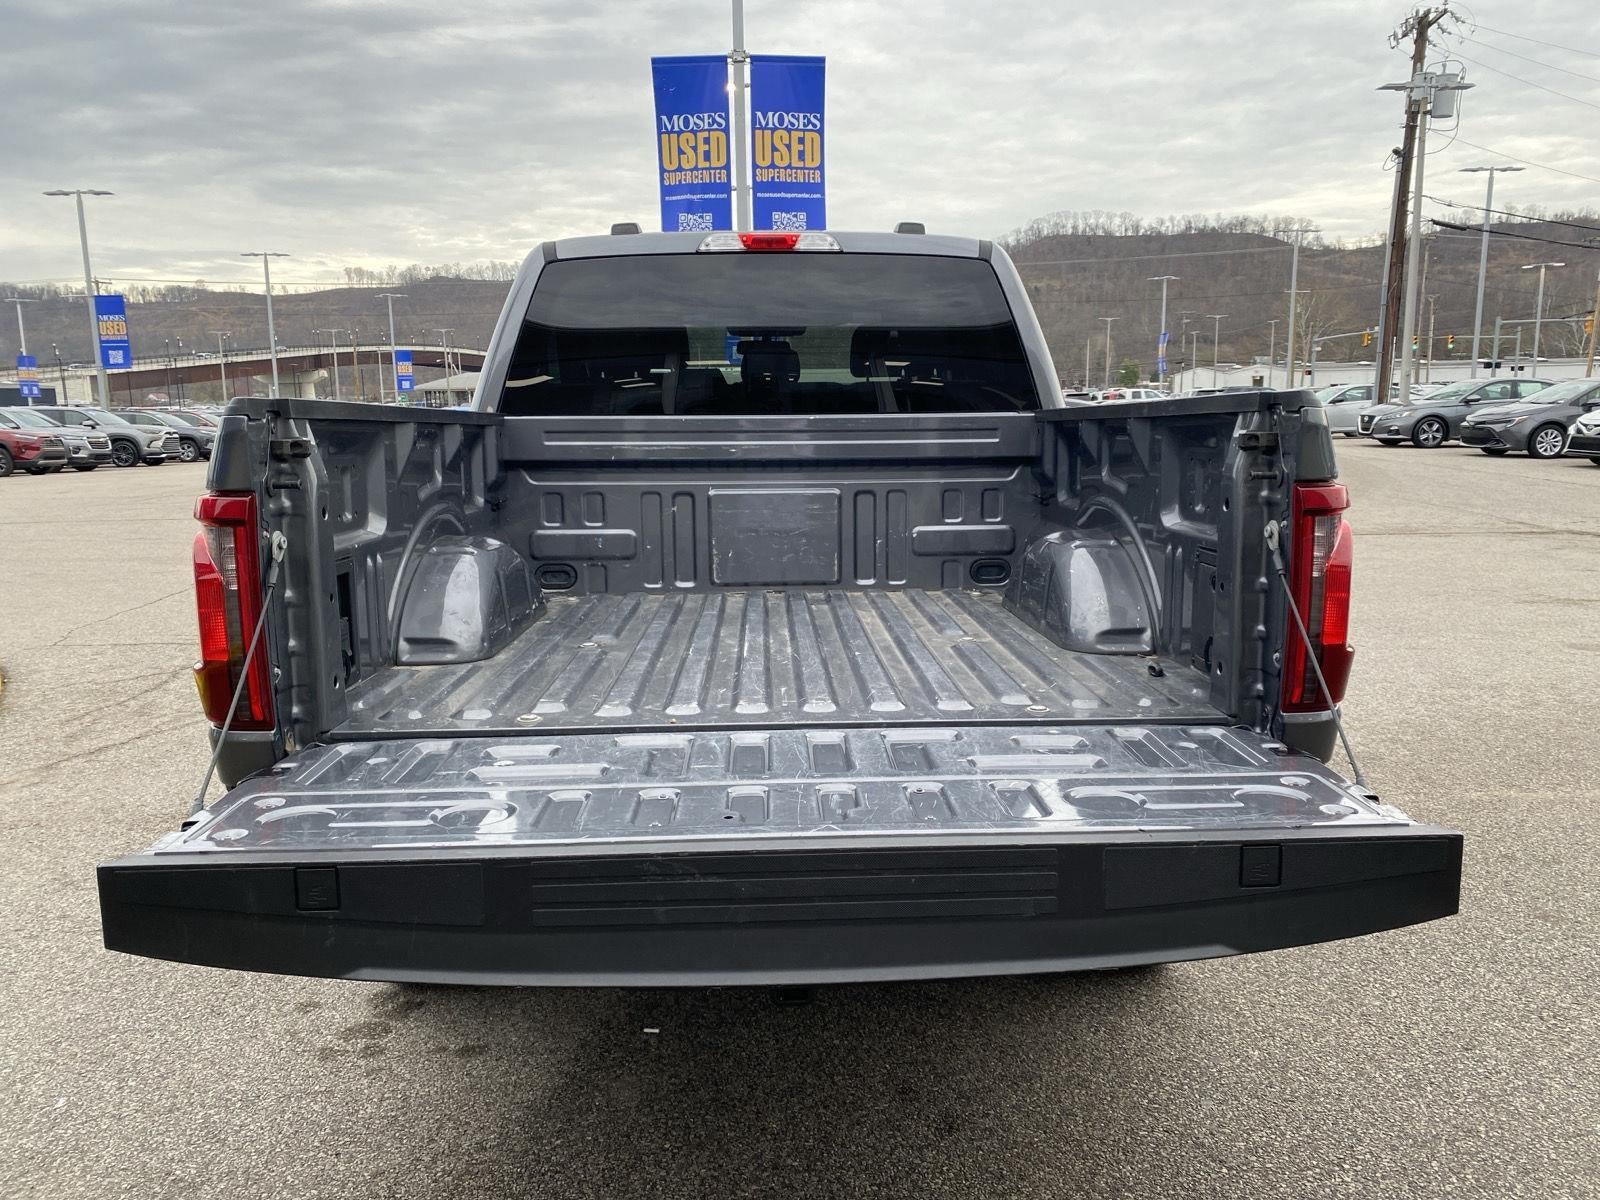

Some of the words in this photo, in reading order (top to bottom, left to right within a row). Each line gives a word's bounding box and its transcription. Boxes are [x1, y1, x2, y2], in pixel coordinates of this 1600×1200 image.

[660, 112, 726, 132] MOSES
[755, 111, 821, 130] MOSES
[661, 131, 727, 170] USED
[754, 129, 821, 168] USED
[664, 170, 727, 186] SUPERCENTER
[756, 168, 821, 183] SUPERCENTER
[99, 321, 127, 335] USED
